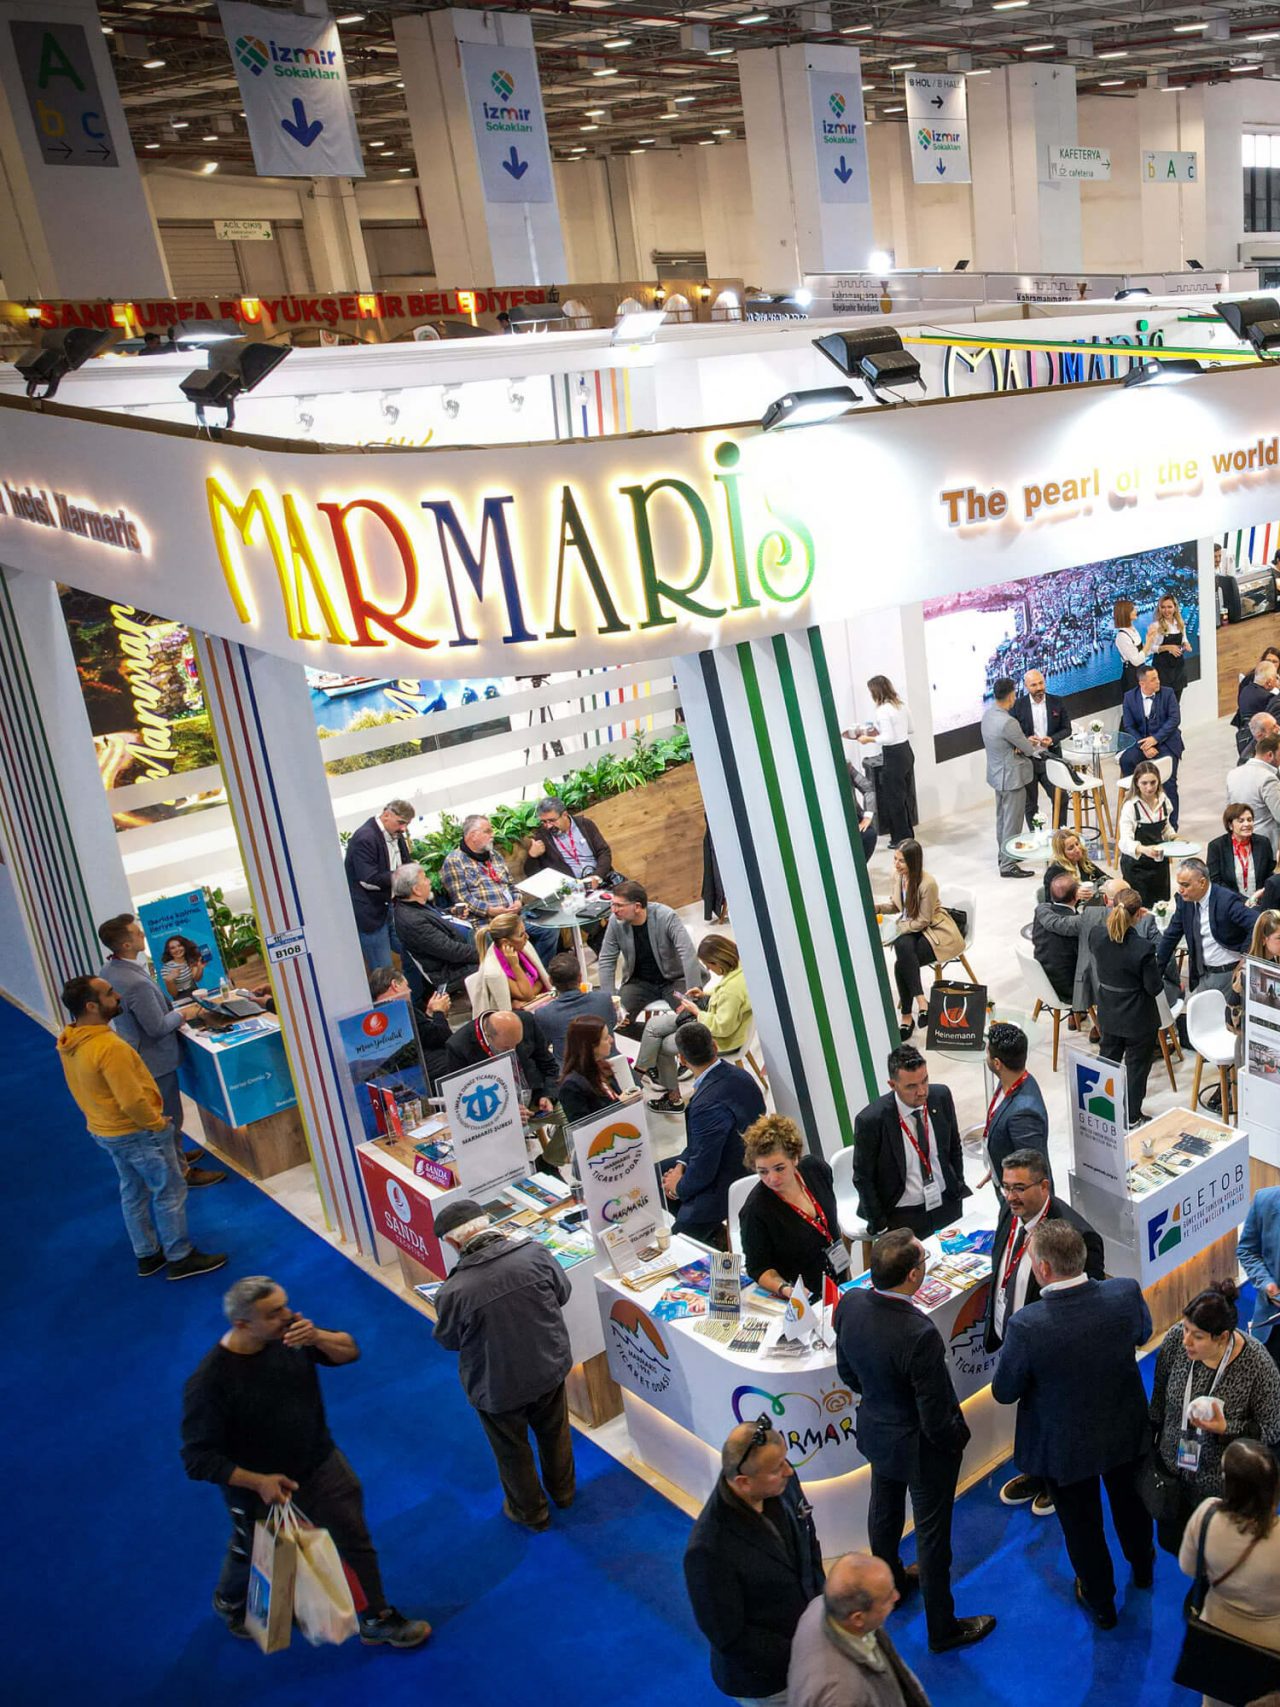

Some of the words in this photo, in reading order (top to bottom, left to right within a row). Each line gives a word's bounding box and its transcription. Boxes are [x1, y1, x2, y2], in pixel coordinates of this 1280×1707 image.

[38, 31, 86, 91] A
[915, 78, 931, 87] HOL
[1059, 148, 1101, 160] KAFETERYA
[1068, 168, 1094, 178] cafeteria
[1166, 159, 1176, 178] A
[941, 486, 1008, 527] The
[1024, 468, 1099, 520] pearl
[1157, 456, 1198, 486] the
[1212, 437, 1279, 474] world
[52, 491, 142, 553] Marmaris
[275, 944, 302, 959] B108
[934, 1029, 976, 1039] Heinemann
[1078, 1112, 1118, 1137] GETOB
[424, 1162, 448, 1181] SANDA
[1182, 1164, 1244, 1217] GETOB
[384, 1210, 430, 1256] SANDA
